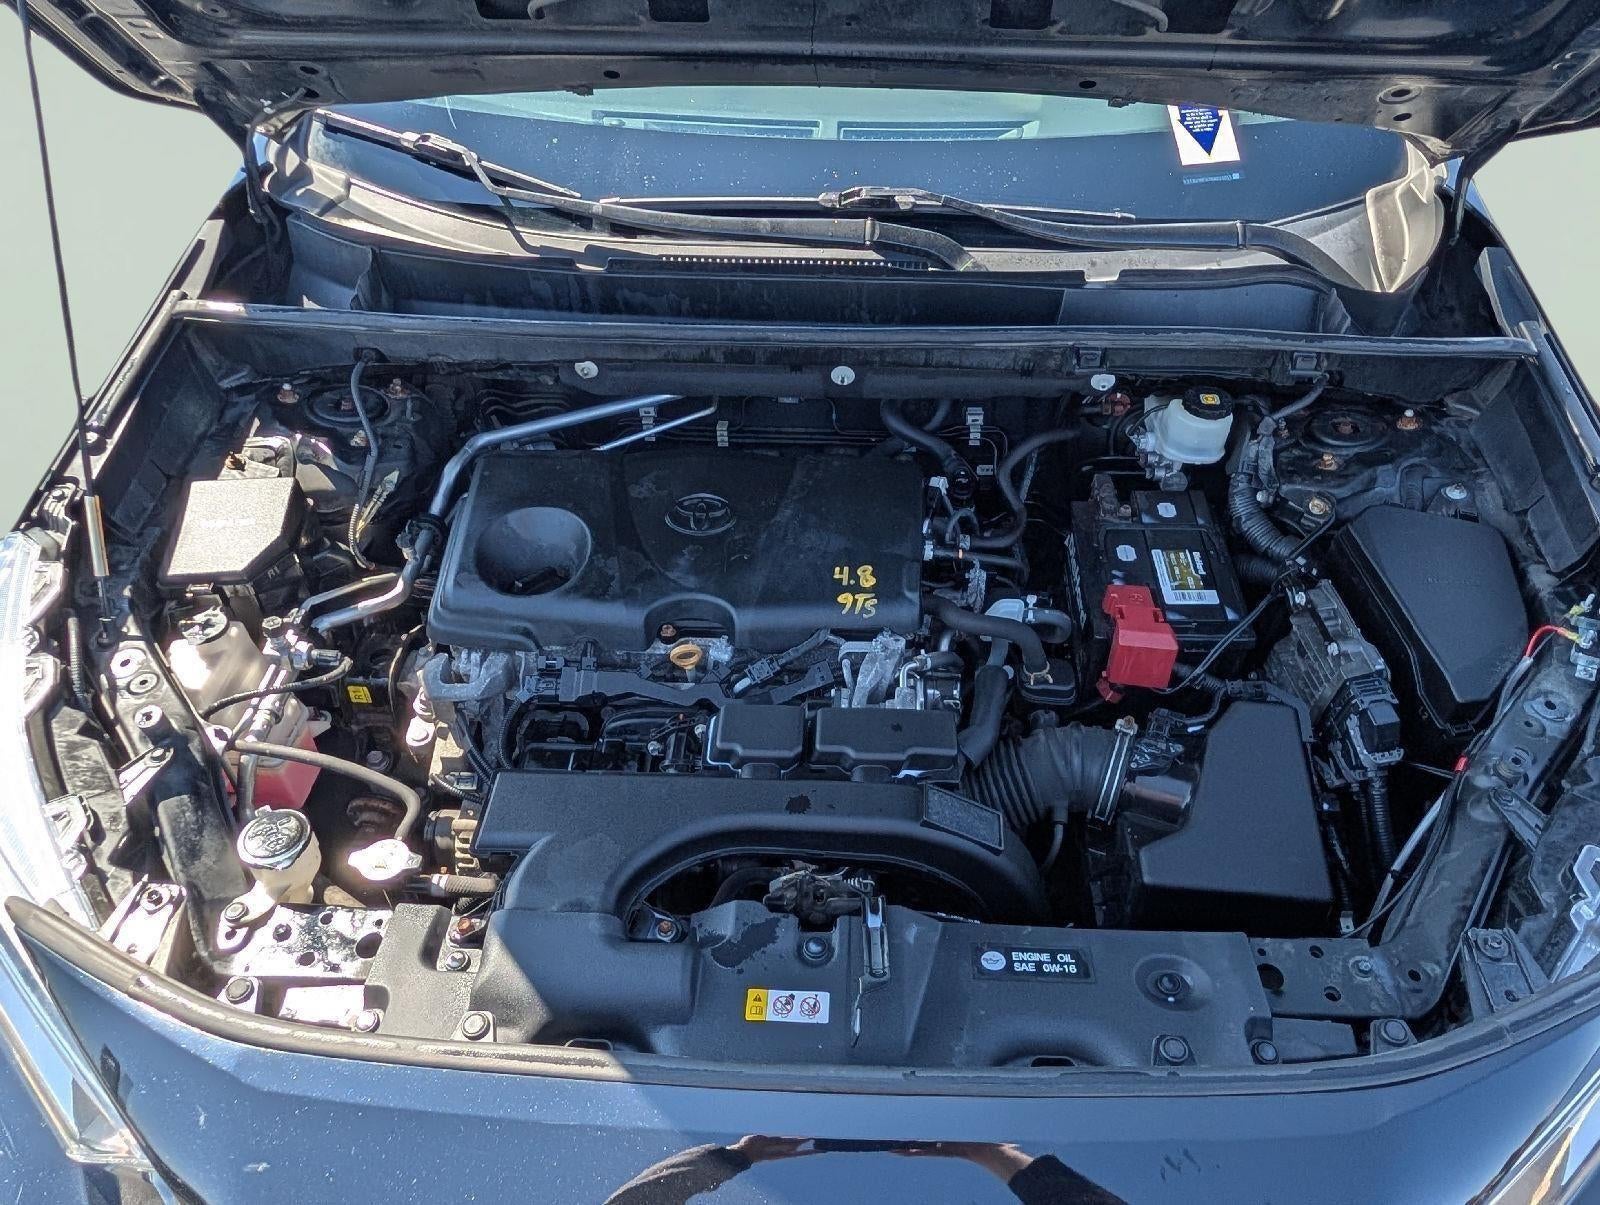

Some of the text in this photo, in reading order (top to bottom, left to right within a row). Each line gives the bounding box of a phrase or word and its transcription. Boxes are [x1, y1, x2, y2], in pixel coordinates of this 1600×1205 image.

[833, 564, 877, 588] 4.8
[1011, 952, 1076, 963] ENGINE OIL
[1013, 962, 1077, 974] SAE 0W-16
